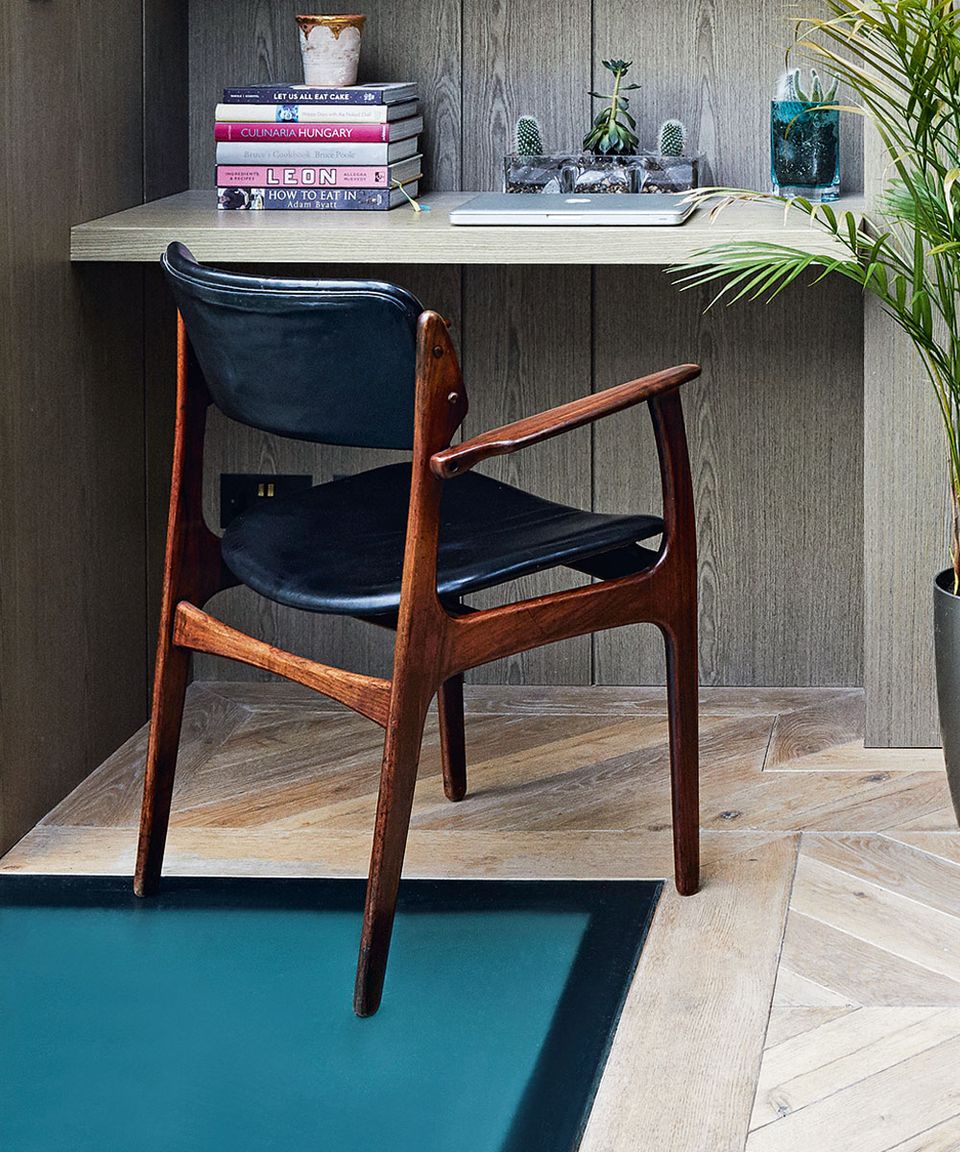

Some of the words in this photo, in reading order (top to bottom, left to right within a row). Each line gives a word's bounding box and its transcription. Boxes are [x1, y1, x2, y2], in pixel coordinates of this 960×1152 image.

[240, 128, 297, 138] CULINARIA
[298, 128, 353, 138] HUNGARY
[314, 150, 334, 159] Bruce
[266, 168, 337, 185] LEON
[269, 190, 298, 200] HOW
[301, 190, 317, 200] TO
[320, 190, 341, 200] EAT
[344, 190, 357, 200] IN
[287, 201, 312, 209] Adam
